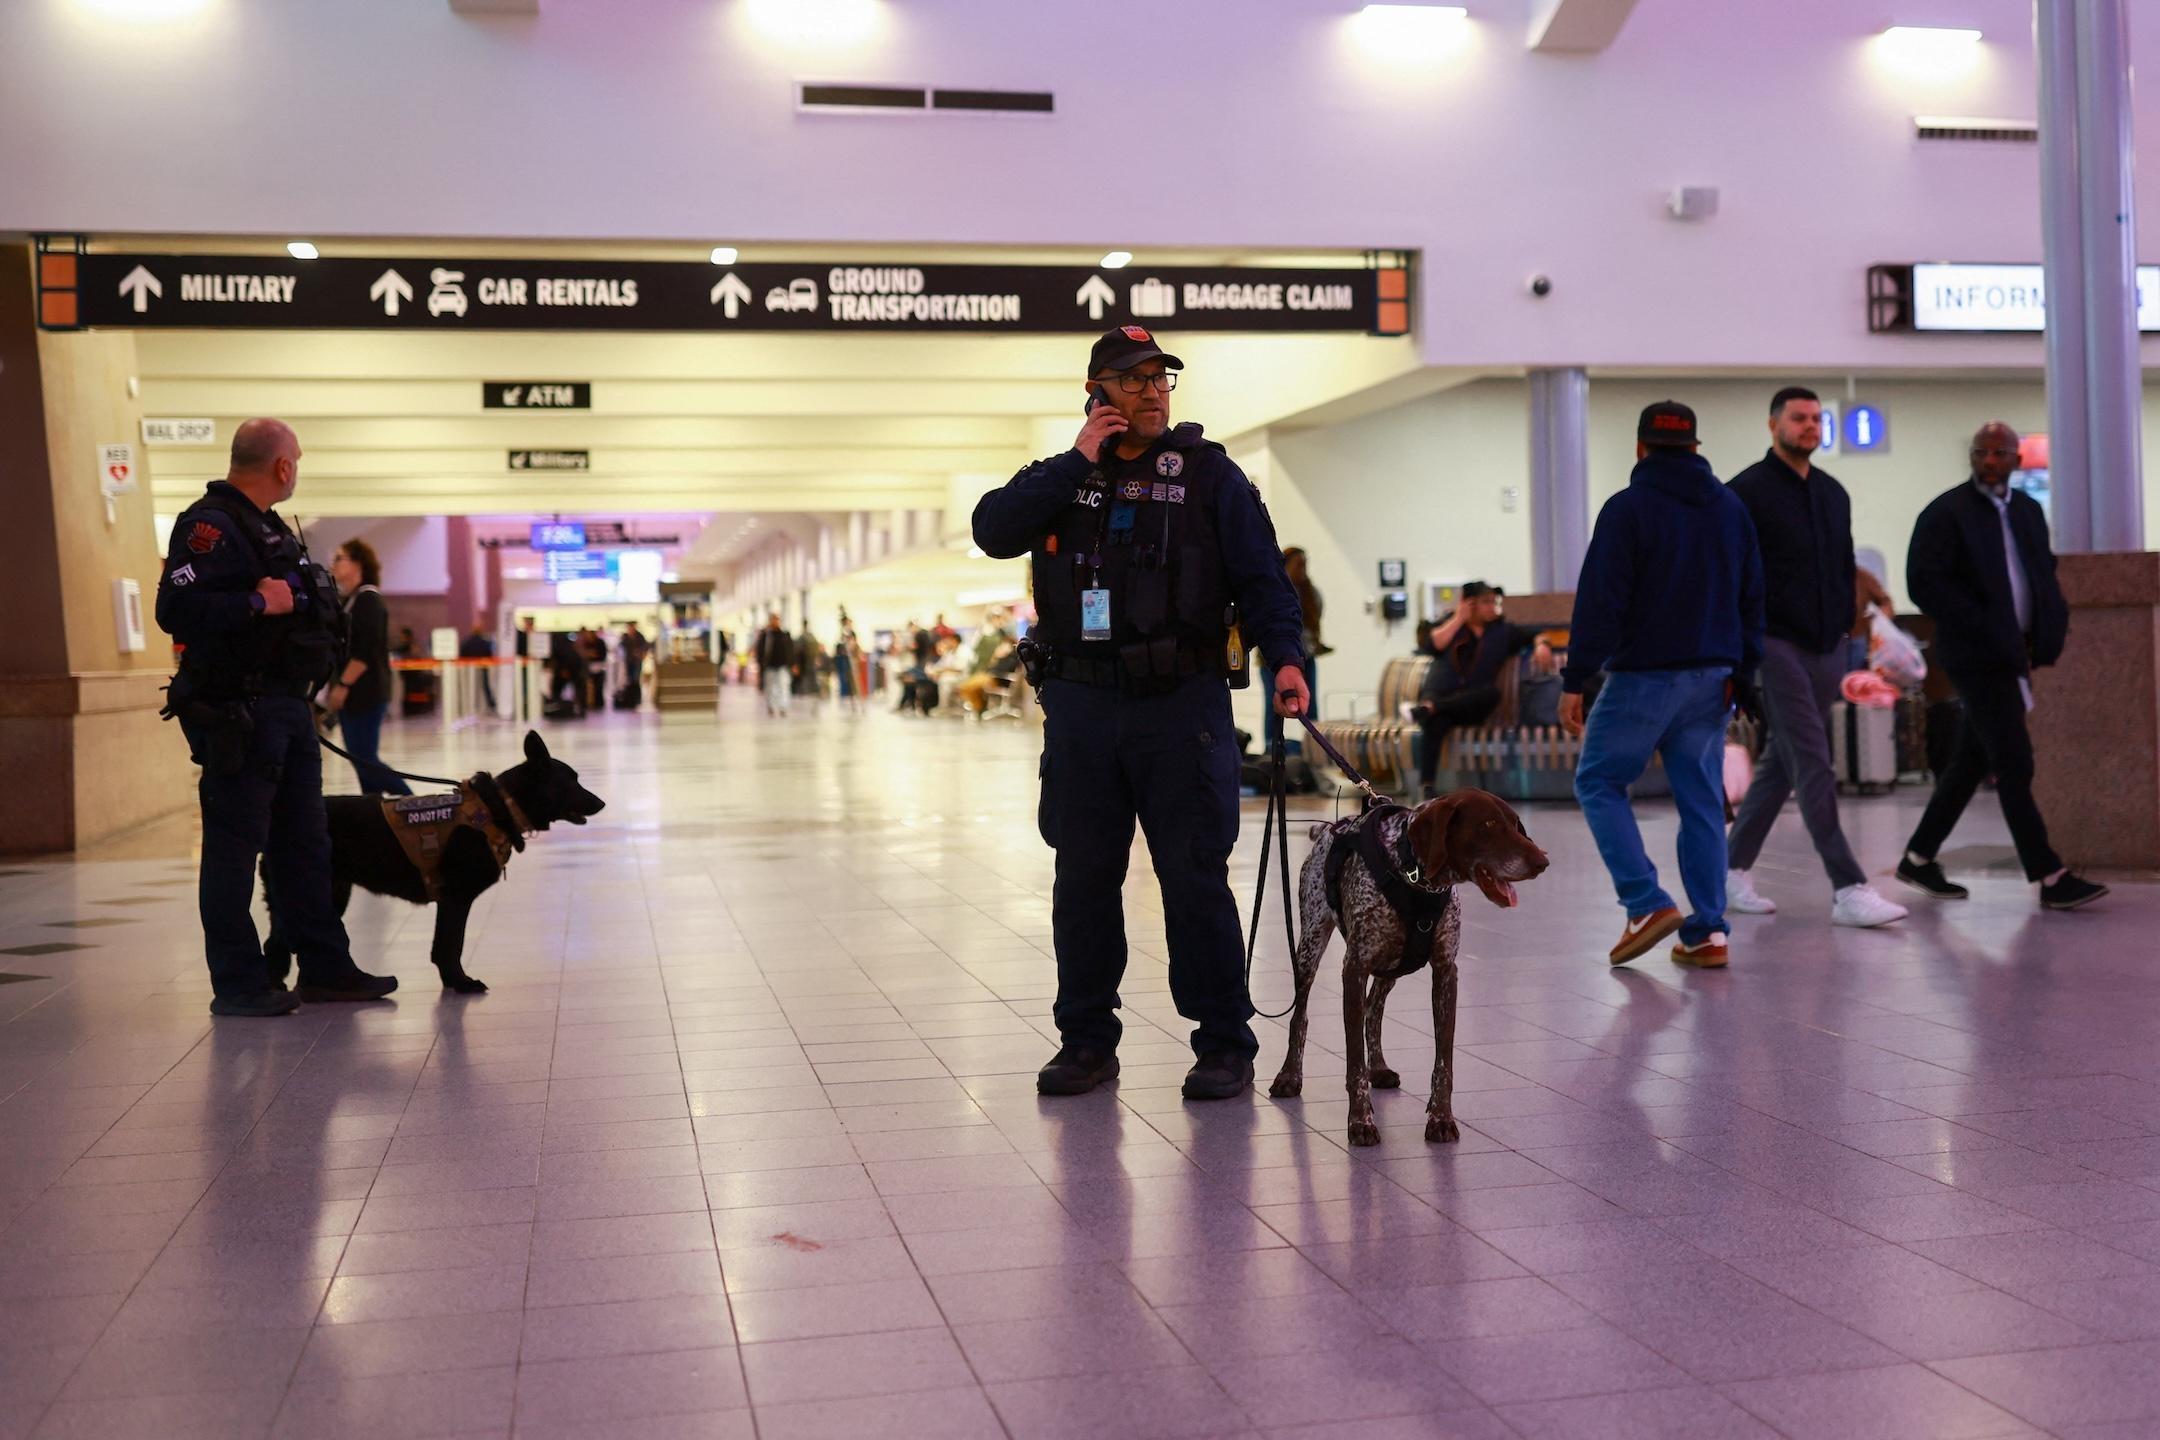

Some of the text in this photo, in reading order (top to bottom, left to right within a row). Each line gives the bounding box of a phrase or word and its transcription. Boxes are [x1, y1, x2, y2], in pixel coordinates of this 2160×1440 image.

[181, 275, 297, 303] MILITARY
[478, 278, 638, 307] CAR RENTALS
[829, 268, 924, 294] GROUND
[828, 294, 1021, 321] TRANSPORTATION
[1183, 284, 1353, 310] BAGGAGE CLAIM
[526, 385, 574, 406] ATM
[146, 423, 211, 440] MAIL DROP
[408, 808, 452, 824] DO NOT PET
